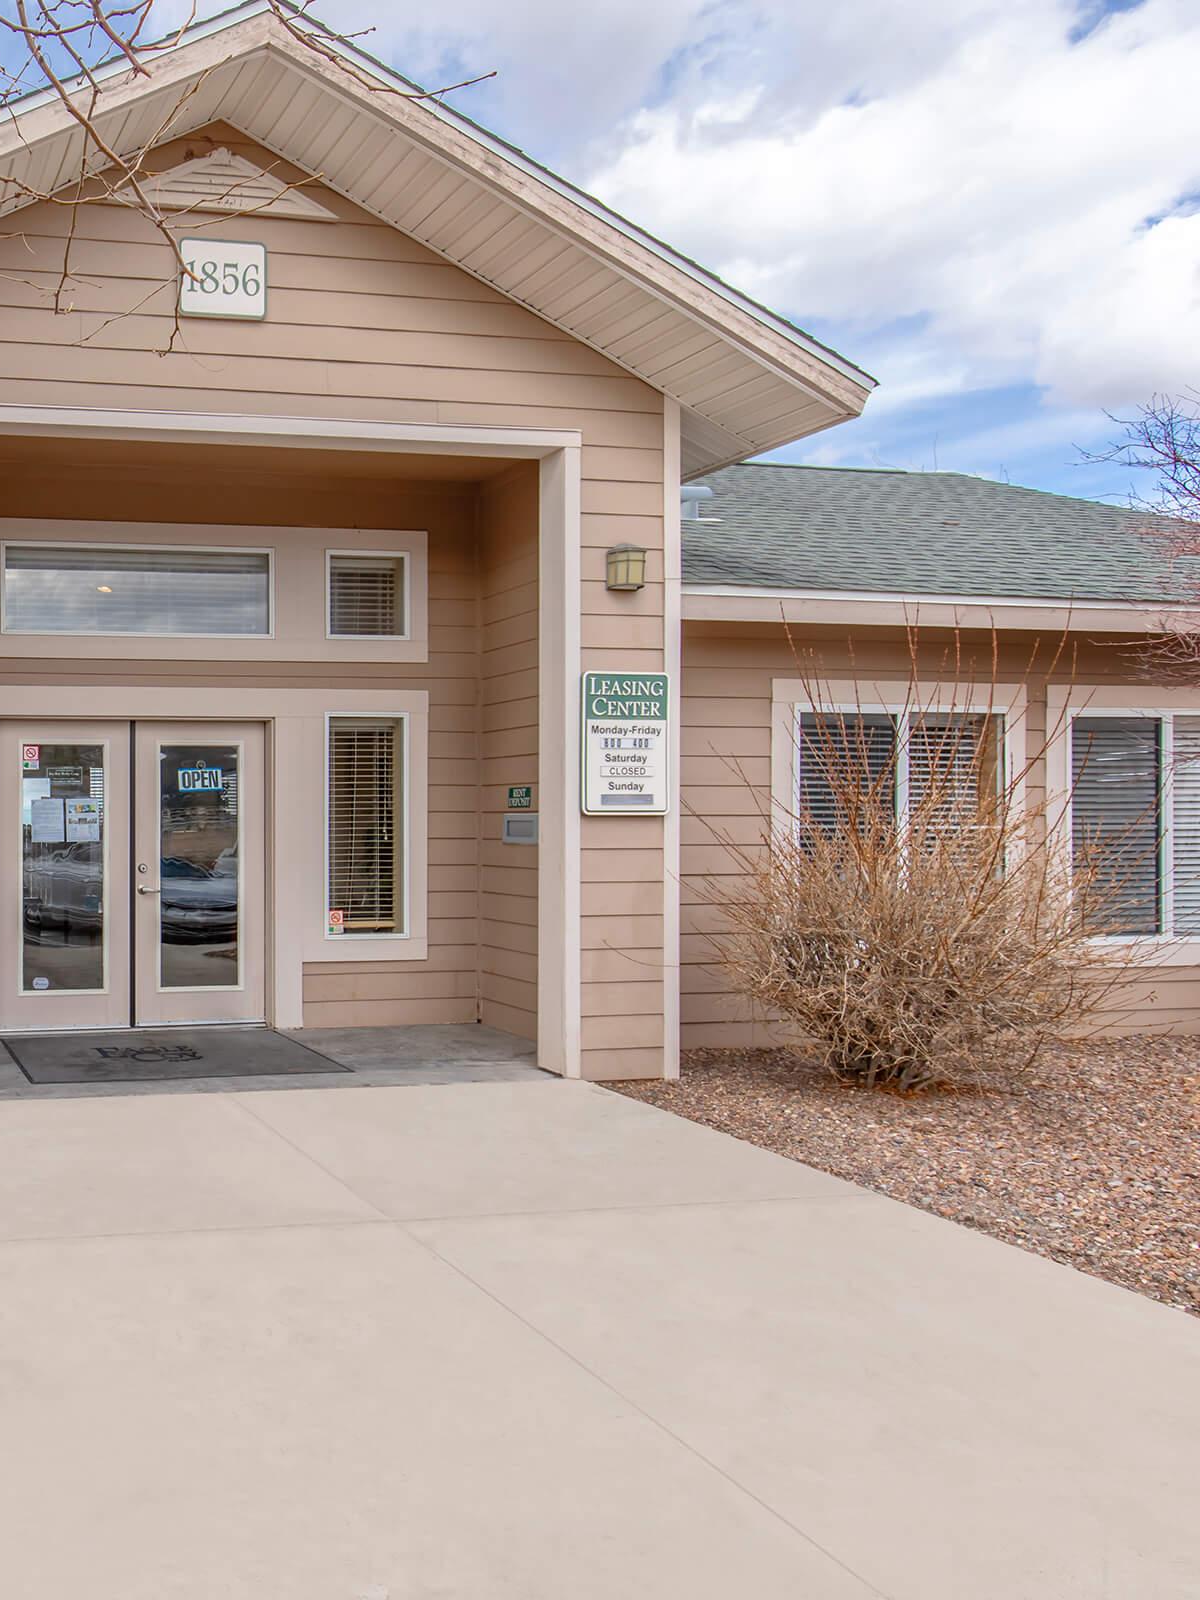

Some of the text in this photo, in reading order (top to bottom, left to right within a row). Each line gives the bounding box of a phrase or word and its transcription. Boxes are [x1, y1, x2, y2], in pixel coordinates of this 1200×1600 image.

[186, 259, 260, 297] 1856
[590, 677, 664, 697] LEASING
[592, 697, 661, 717] CENTER
[591, 725, 662, 737] Monday-Friday
[605, 753, 648, 764] Saturday
[182, 770, 219, 788] OPEN
[609, 767, 646, 776] CLOSED
[608, 781, 645, 793] Sunday
